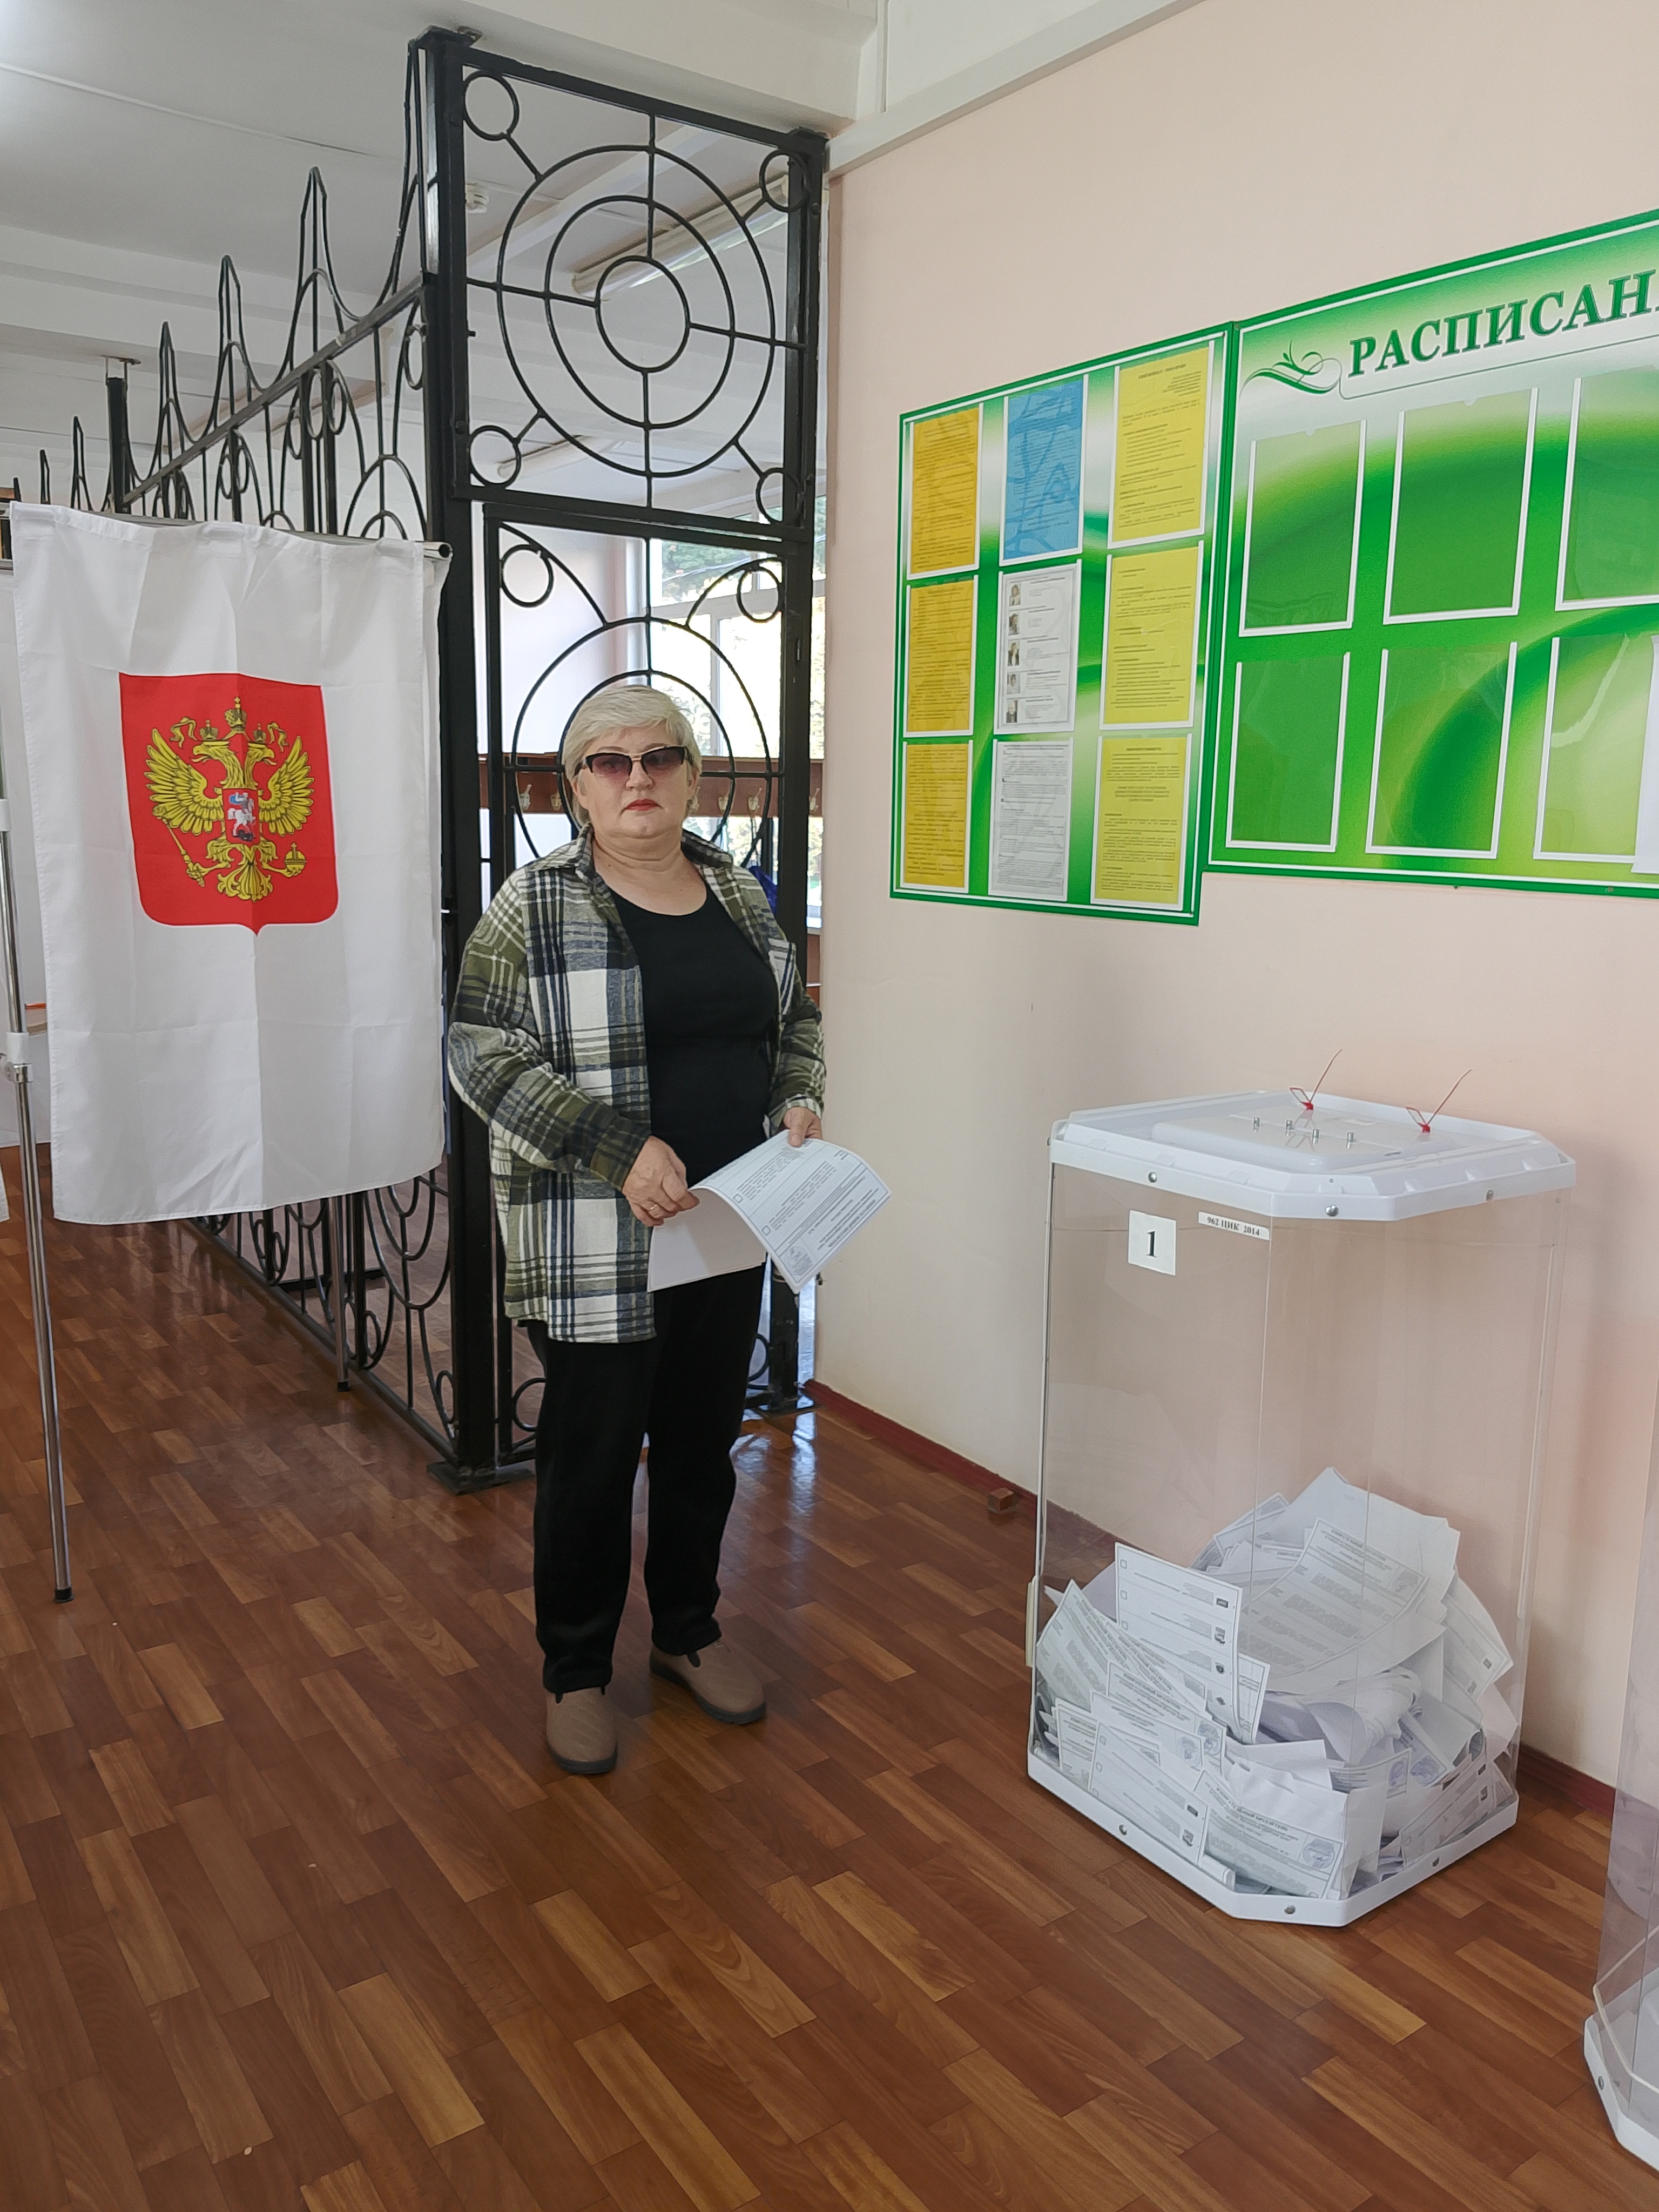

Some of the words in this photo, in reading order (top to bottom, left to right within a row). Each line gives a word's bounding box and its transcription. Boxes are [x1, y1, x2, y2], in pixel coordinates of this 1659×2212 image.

[1348, 269, 1659, 378] РАСПИСАН
[1221, 1219, 1240, 1231] ЦИК
[1243, 1225, 1260, 1236] 2014
[1147, 1231, 1157, 1258] 1
